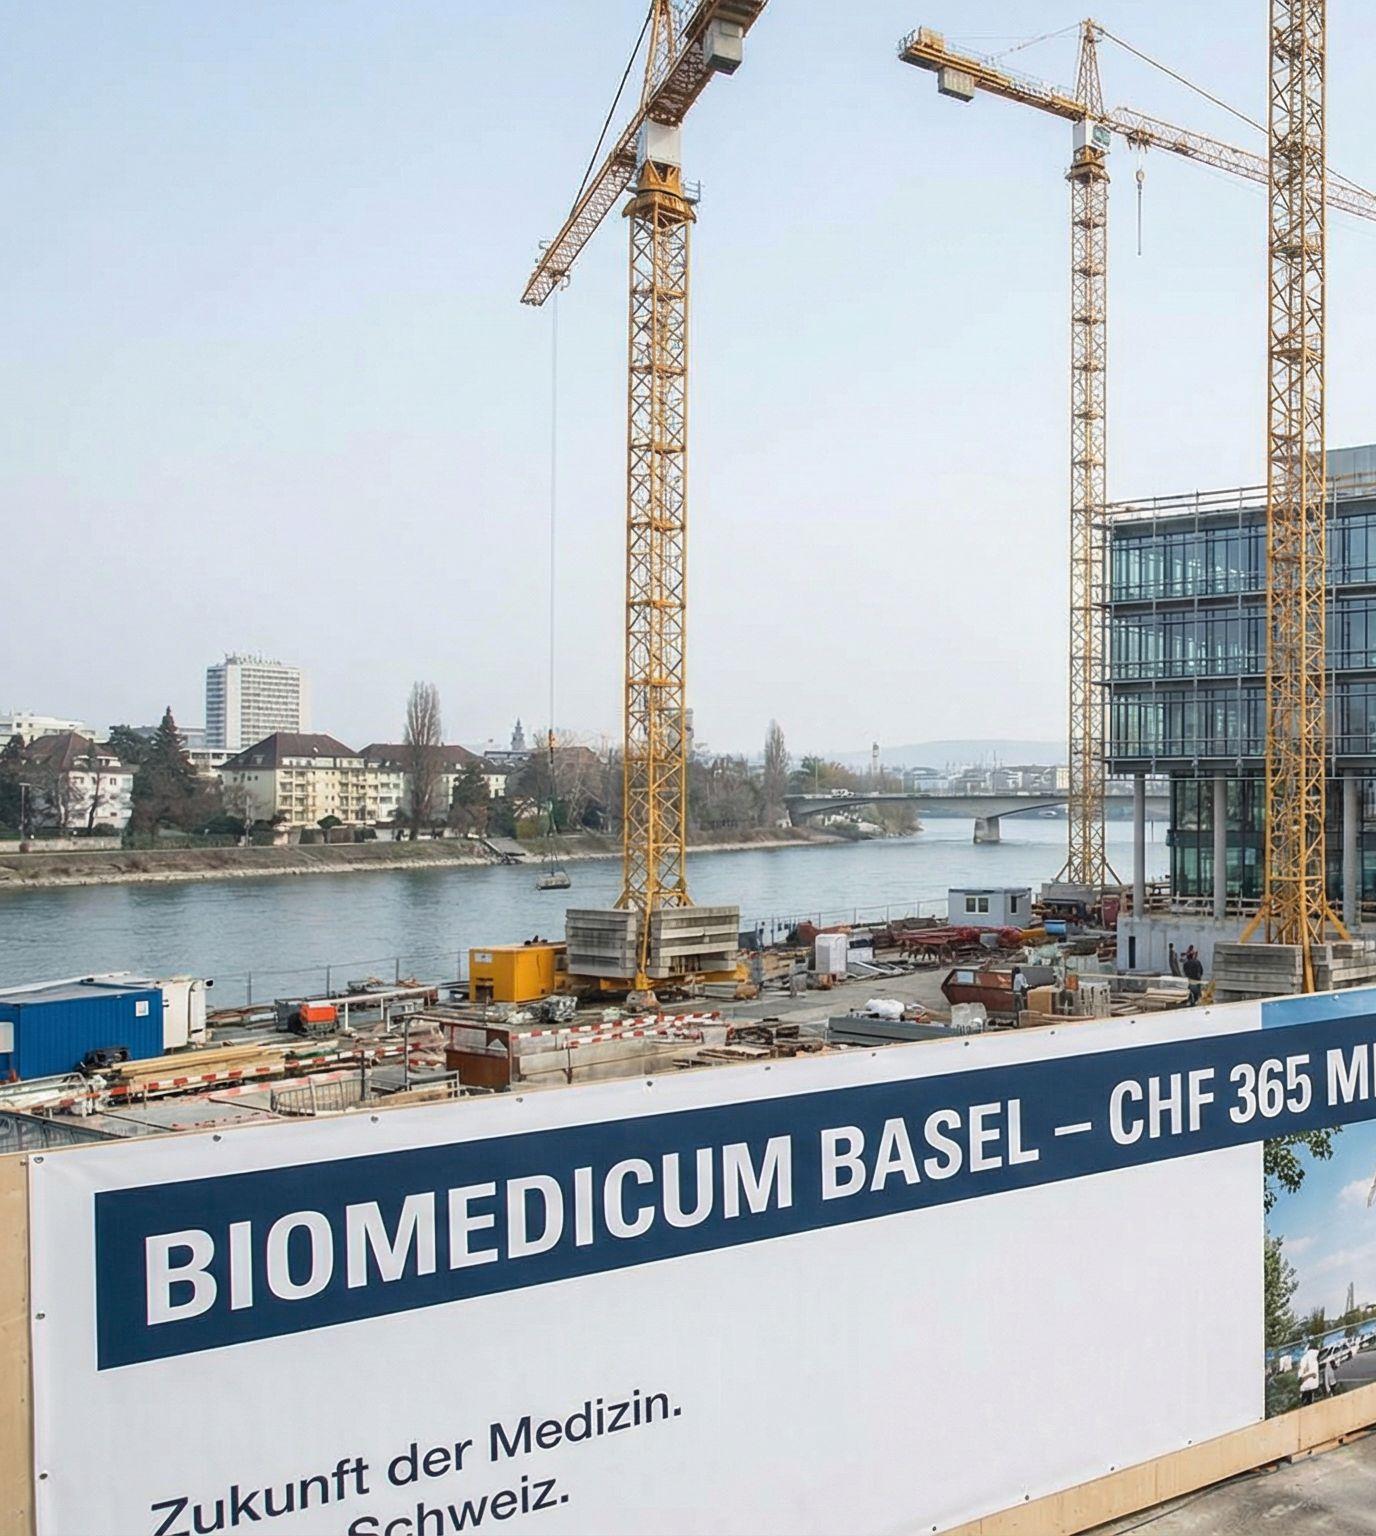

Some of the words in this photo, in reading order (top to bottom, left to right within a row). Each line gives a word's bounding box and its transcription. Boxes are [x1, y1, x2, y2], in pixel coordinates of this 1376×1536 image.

[145, 1134, 793, 1326] BIOMEDICUM
[820, 1098, 1040, 1201] BASEL
[1109, 1067, 1215, 1145] CHF
[1229, 1053, 1312, 1124] 365
[150, 1457, 370, 1536] Zukunft
[387, 1439, 473, 1487] der
[490, 1389, 682, 1462] Medizin.
